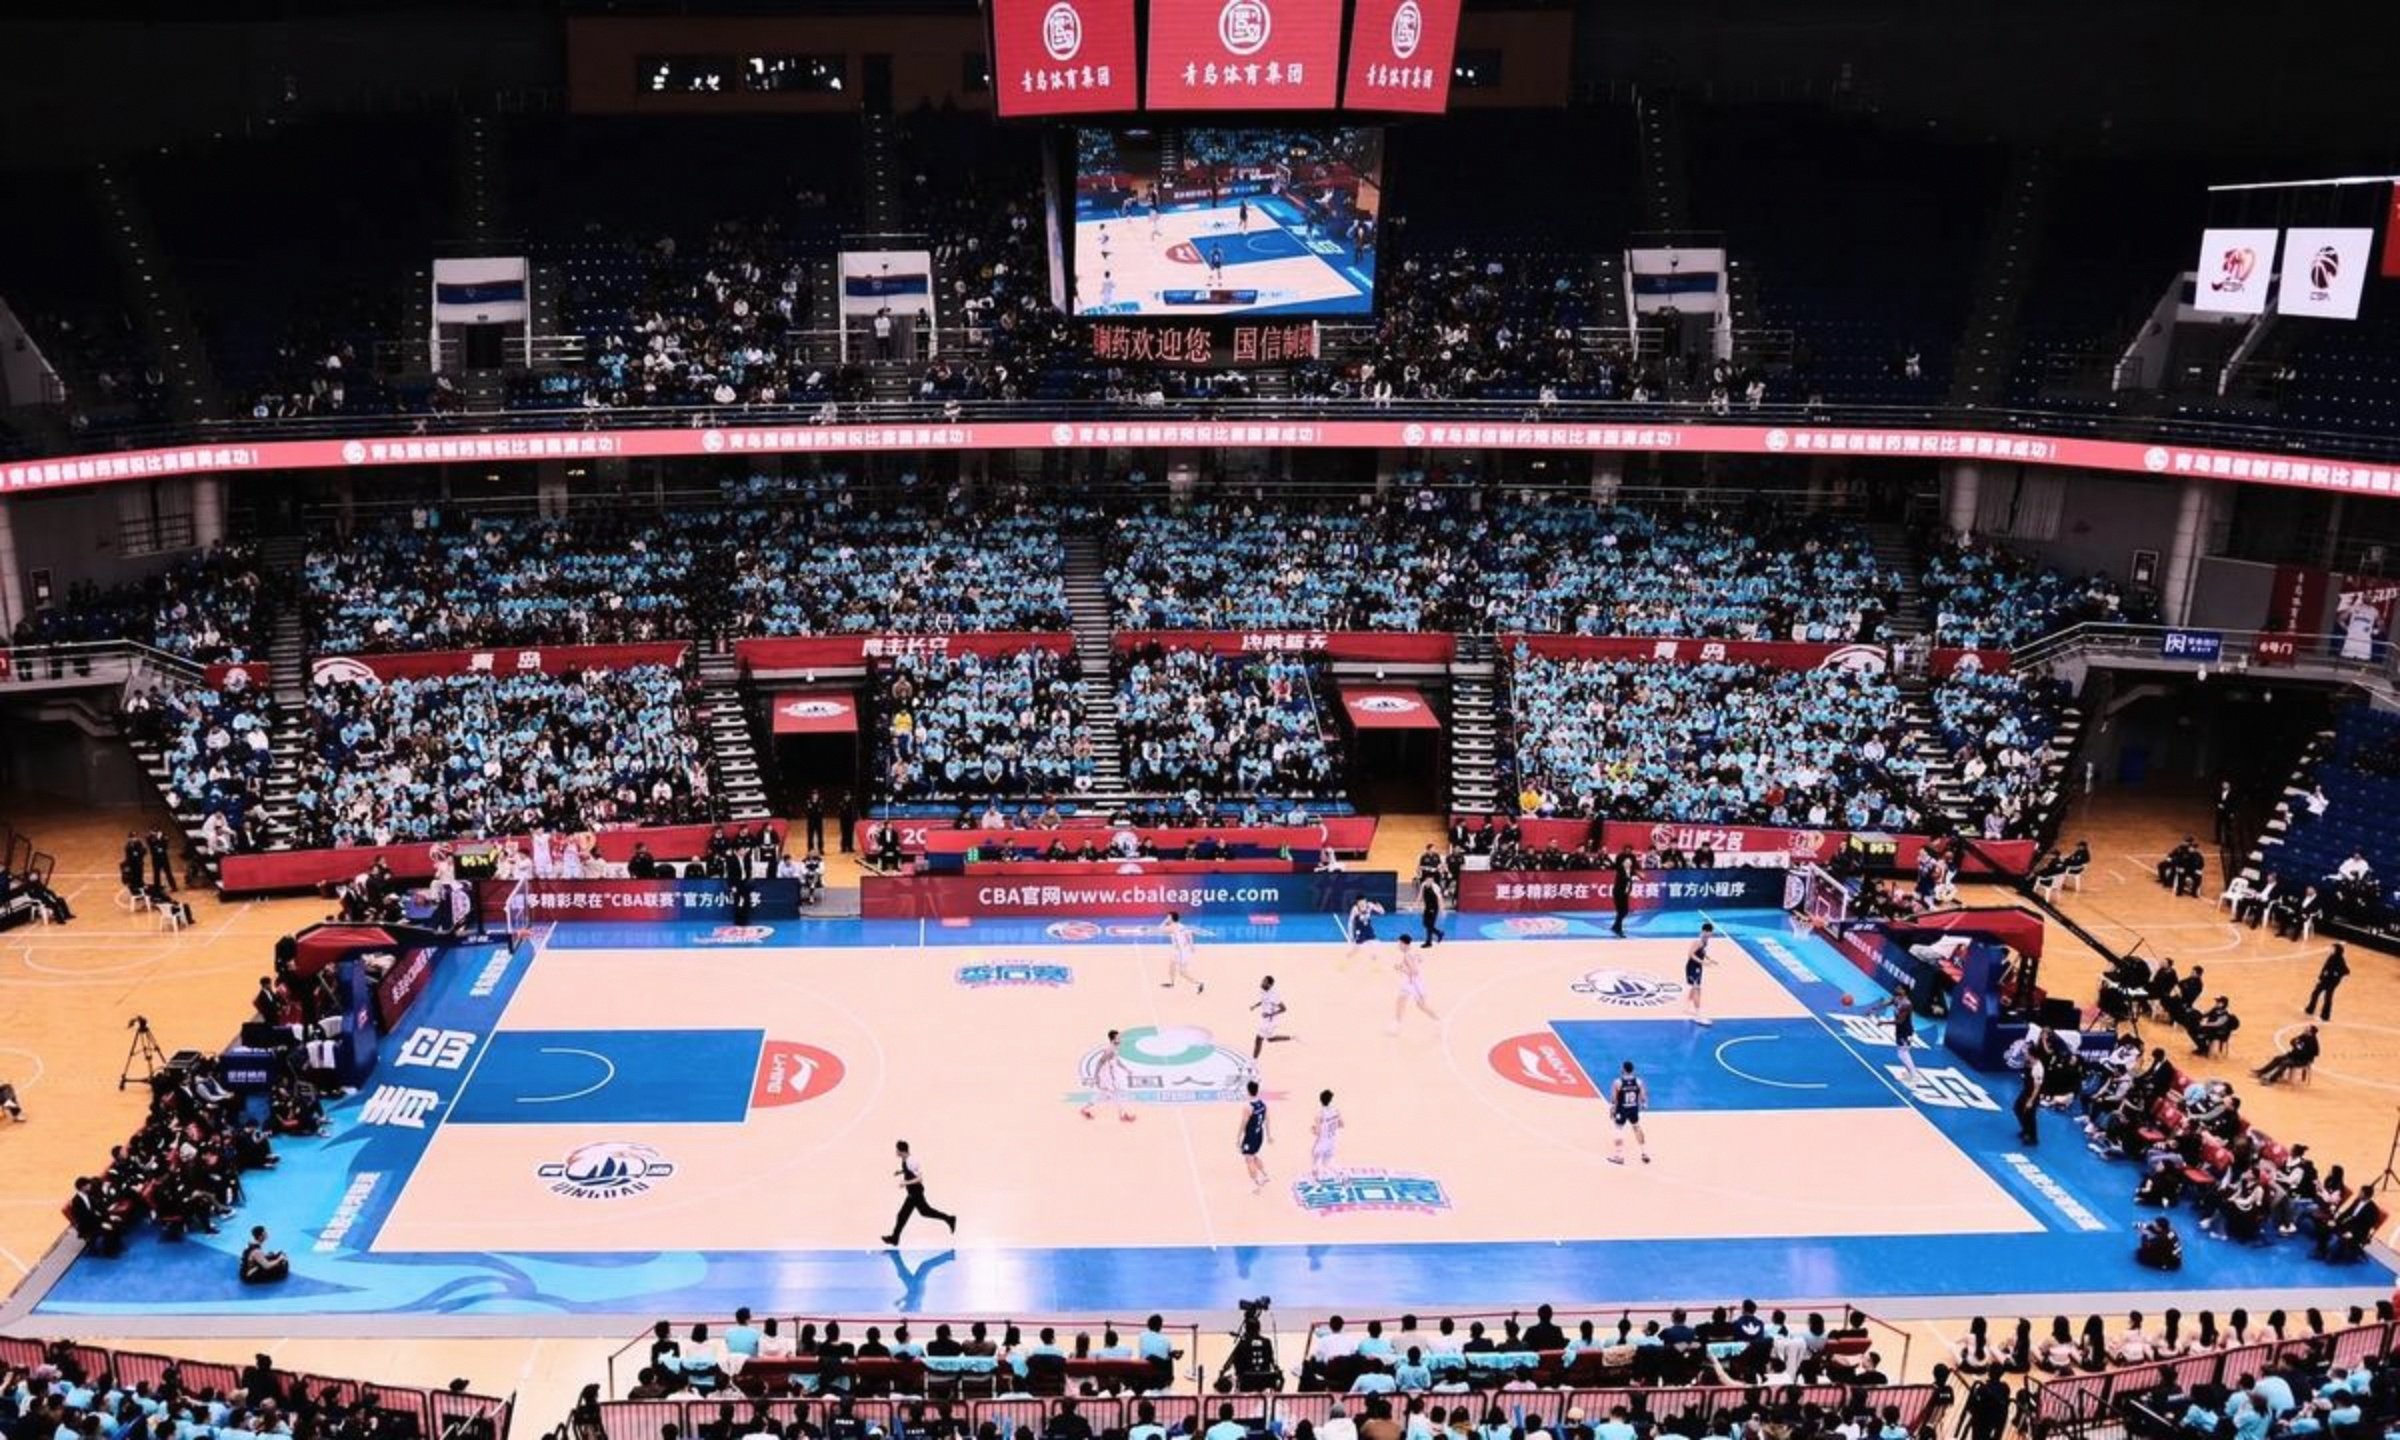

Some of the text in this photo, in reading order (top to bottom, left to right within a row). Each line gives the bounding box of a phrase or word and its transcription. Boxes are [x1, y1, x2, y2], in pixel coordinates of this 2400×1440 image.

[1021, 65, 1110, 92] 青岛体育集团
[1181, 62, 1303, 86] 青岛体育集团
[1366, 63, 1433, 88] 青岛体育集团
[978, 885, 1280, 906] CBA官网www.cbaleague.com
